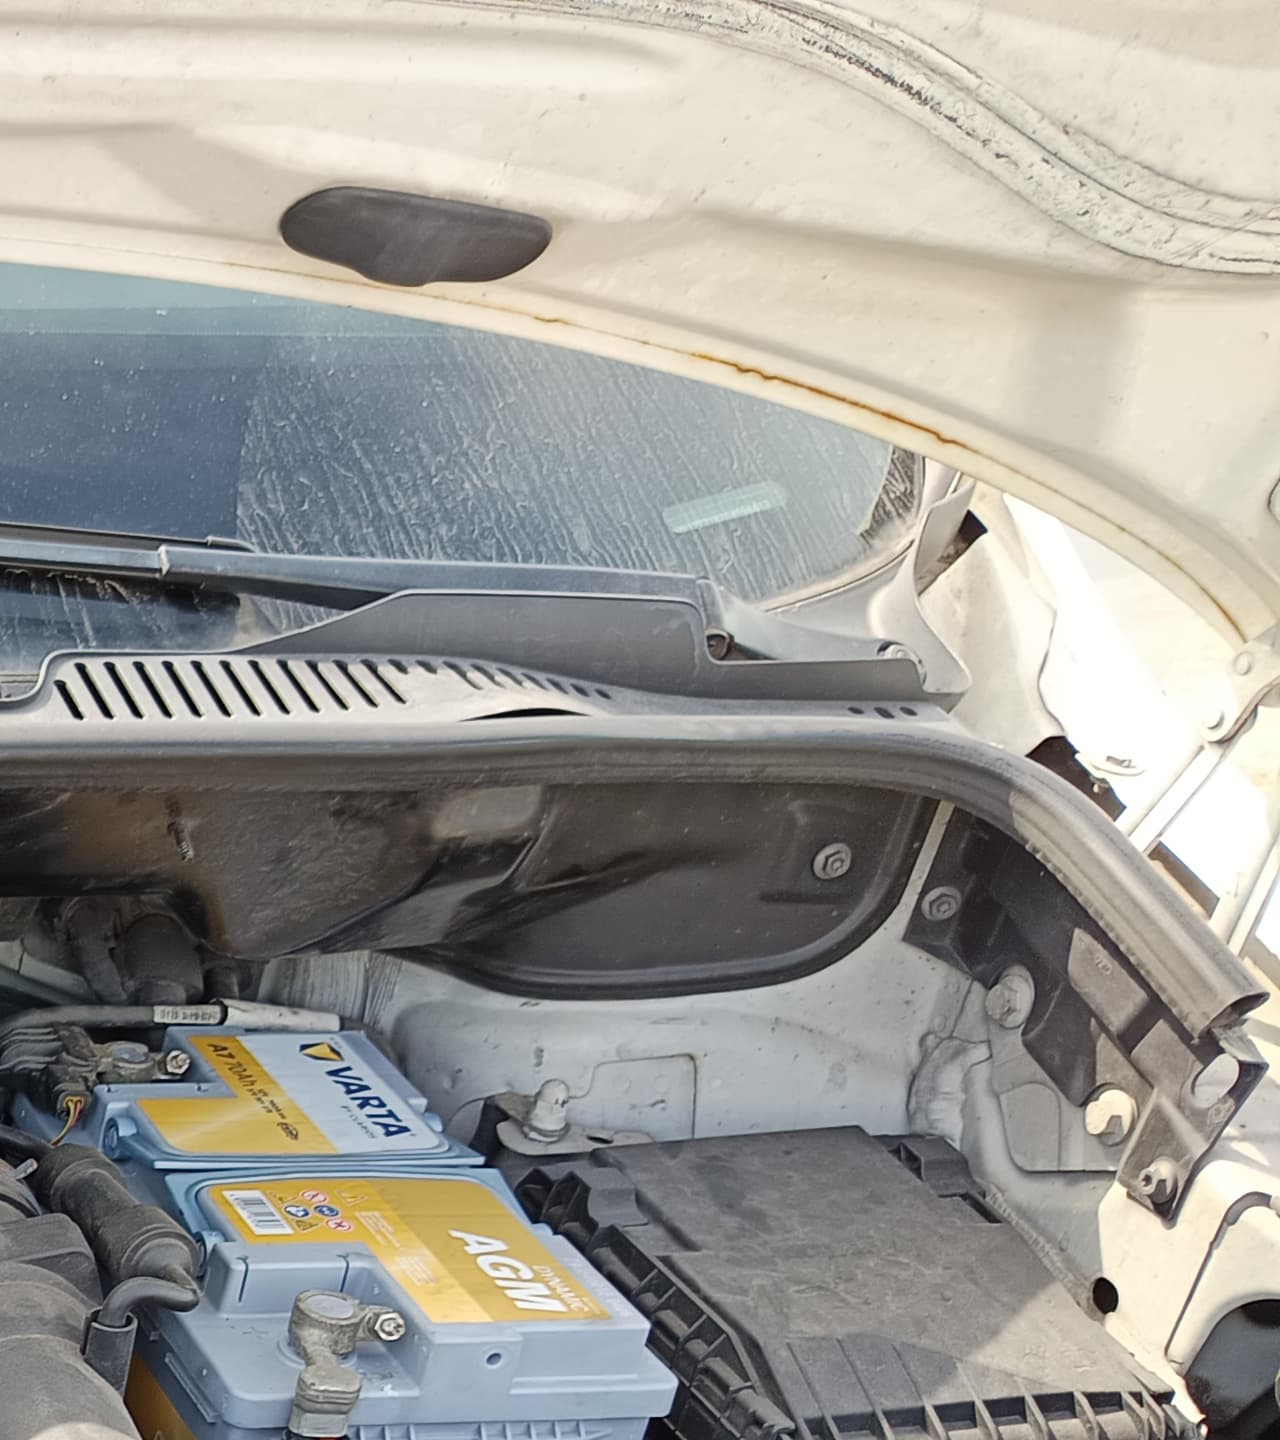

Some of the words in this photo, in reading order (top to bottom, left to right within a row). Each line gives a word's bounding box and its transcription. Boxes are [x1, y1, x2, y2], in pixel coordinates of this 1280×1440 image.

[207, 1042, 235, 1063] A7
[325, 1066, 412, 1137] VARTA
[448, 1229, 569, 1313] AGM
[532, 1265, 592, 1313] DYNAMIC
